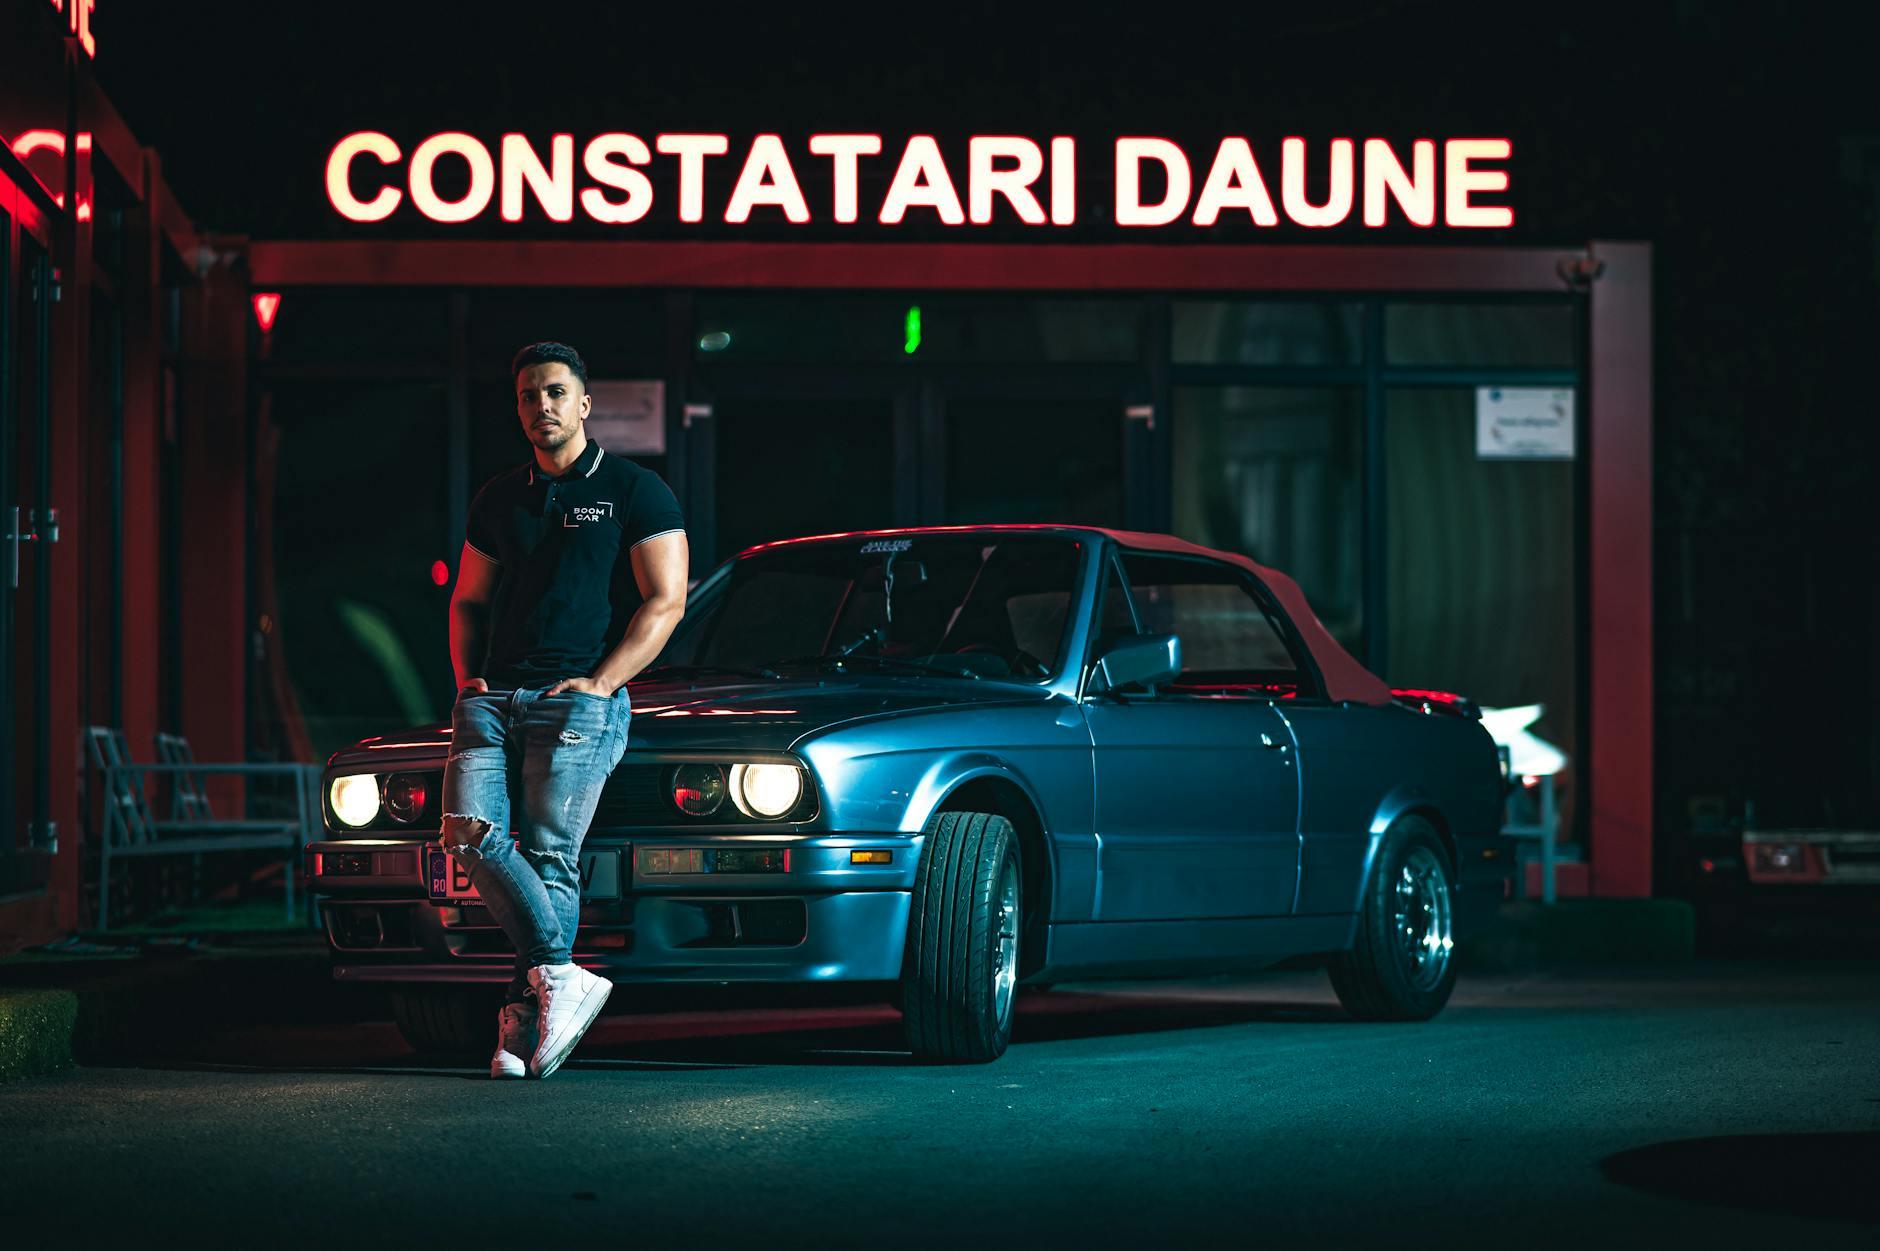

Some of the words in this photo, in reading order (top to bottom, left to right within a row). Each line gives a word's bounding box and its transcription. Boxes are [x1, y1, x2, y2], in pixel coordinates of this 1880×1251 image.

[323, 130, 1076, 226] CONSTATARI
[1113, 135, 1515, 228] DAUNE
[574, 507, 604, 515] BOOM
[576, 514, 600, 522] CAR
[433, 878, 446, 893] RO
